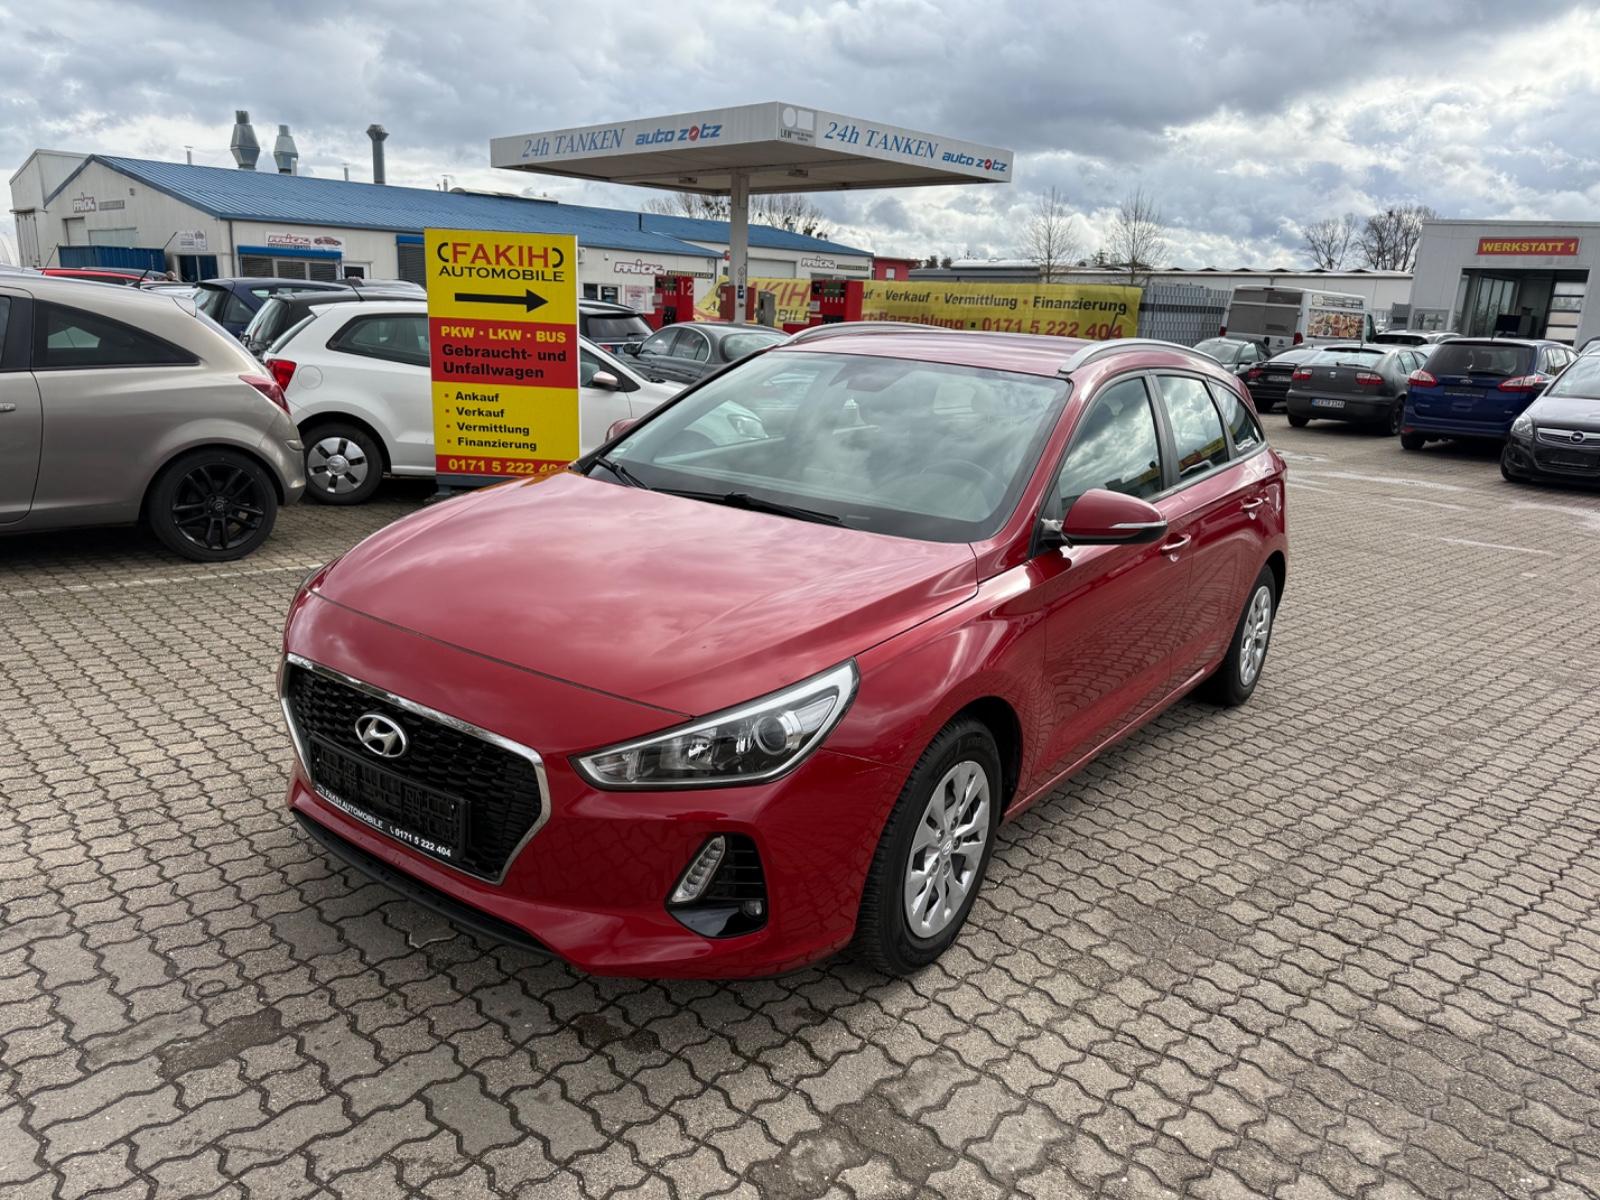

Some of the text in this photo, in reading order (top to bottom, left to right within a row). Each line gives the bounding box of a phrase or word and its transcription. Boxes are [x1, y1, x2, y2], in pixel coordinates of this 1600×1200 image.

[522, 128, 625, 157] 24h TANKEN
[635, 130, 675, 145] auto
[824, 121, 938, 159] 24h TANKEN
[942, 151, 974, 166] auto
[1482, 242, 1576, 252] WERKSTATT 1
[438, 265, 565, 282] AUTOMOBILE
[680, 281, 694, 296] 12
[885, 290, 932, 303] Verkauf
[944, 293, 1018, 309] Vermittlung
[1033, 296, 1127, 316] Finanzierung
[440, 326, 566, 343] PKW LKW BUS
[982, 317, 1022, 332] 0171
[1030, 320, 1040, 334] 5
[1045, 321, 1078, 337] 222
[1084, 323, 1122, 340] 404
[442, 344, 566, 362] Gebraucht- und
[443, 361, 544, 380] Unfallwagen
[455, 391, 499, 402] Ankauf
[456, 407, 505, 418] Verkauf
[457, 422, 530, 436] Vermittlung
[458, 437, 537, 452] Finanzierung
[448, 459, 485, 471] 0171
[492, 461, 501, 472] 5
[506, 461, 535, 474] 222
[341, 800, 383, 829] AUTOMOBILE
[395, 828, 451, 857] 0171 5 222 404
